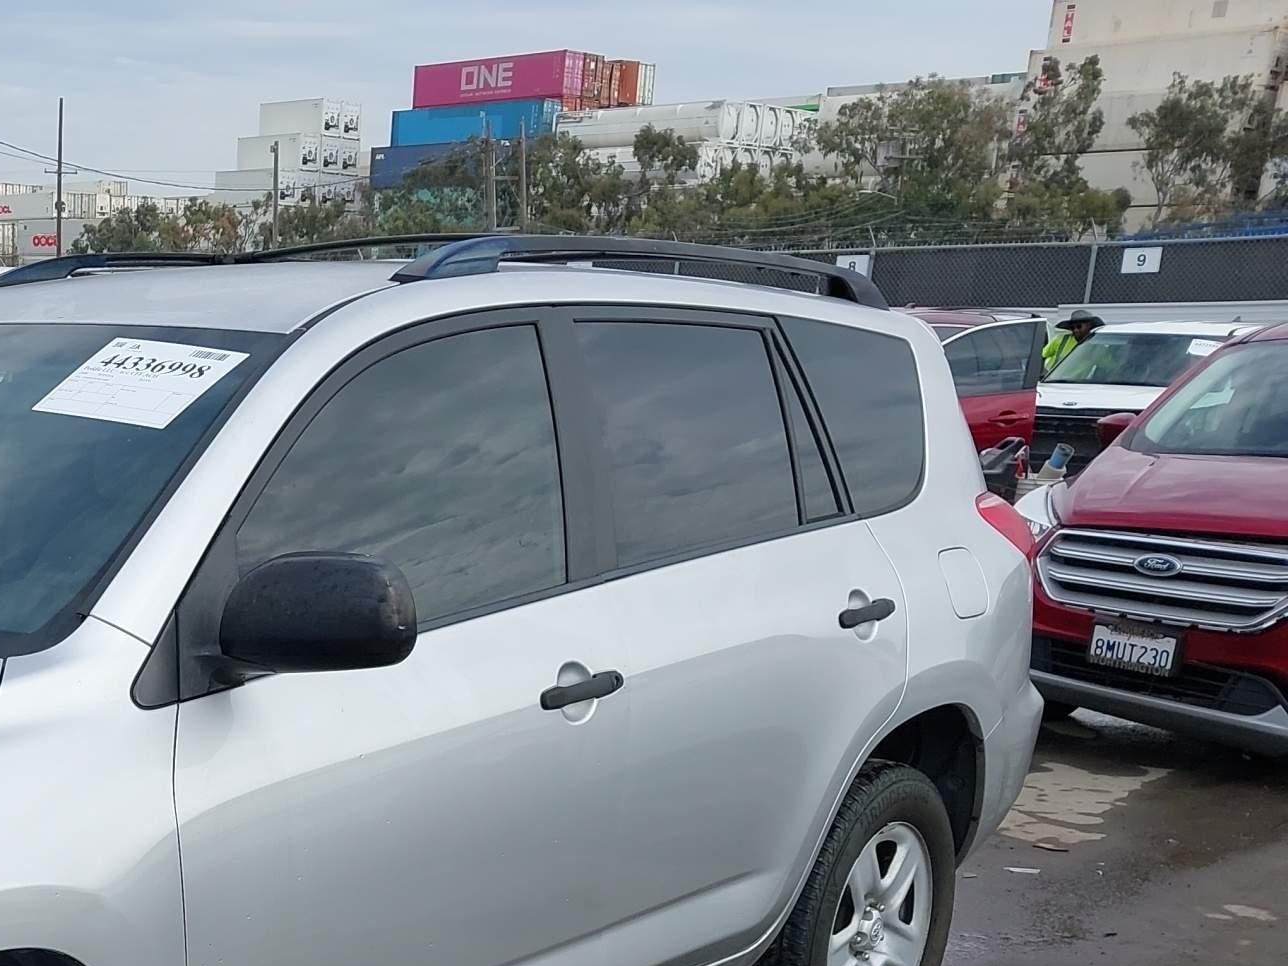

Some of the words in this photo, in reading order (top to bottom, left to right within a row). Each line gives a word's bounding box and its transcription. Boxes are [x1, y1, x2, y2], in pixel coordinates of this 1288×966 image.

[460, 62, 514, 90] ONE
[849, 261, 856, 271] 8
[1137, 254, 1146, 267] 9
[100, 353, 212, 379] 44336998
[1143, 559, 1170, 571] Ford
[1094, 638, 1170, 669] 8MUT230
